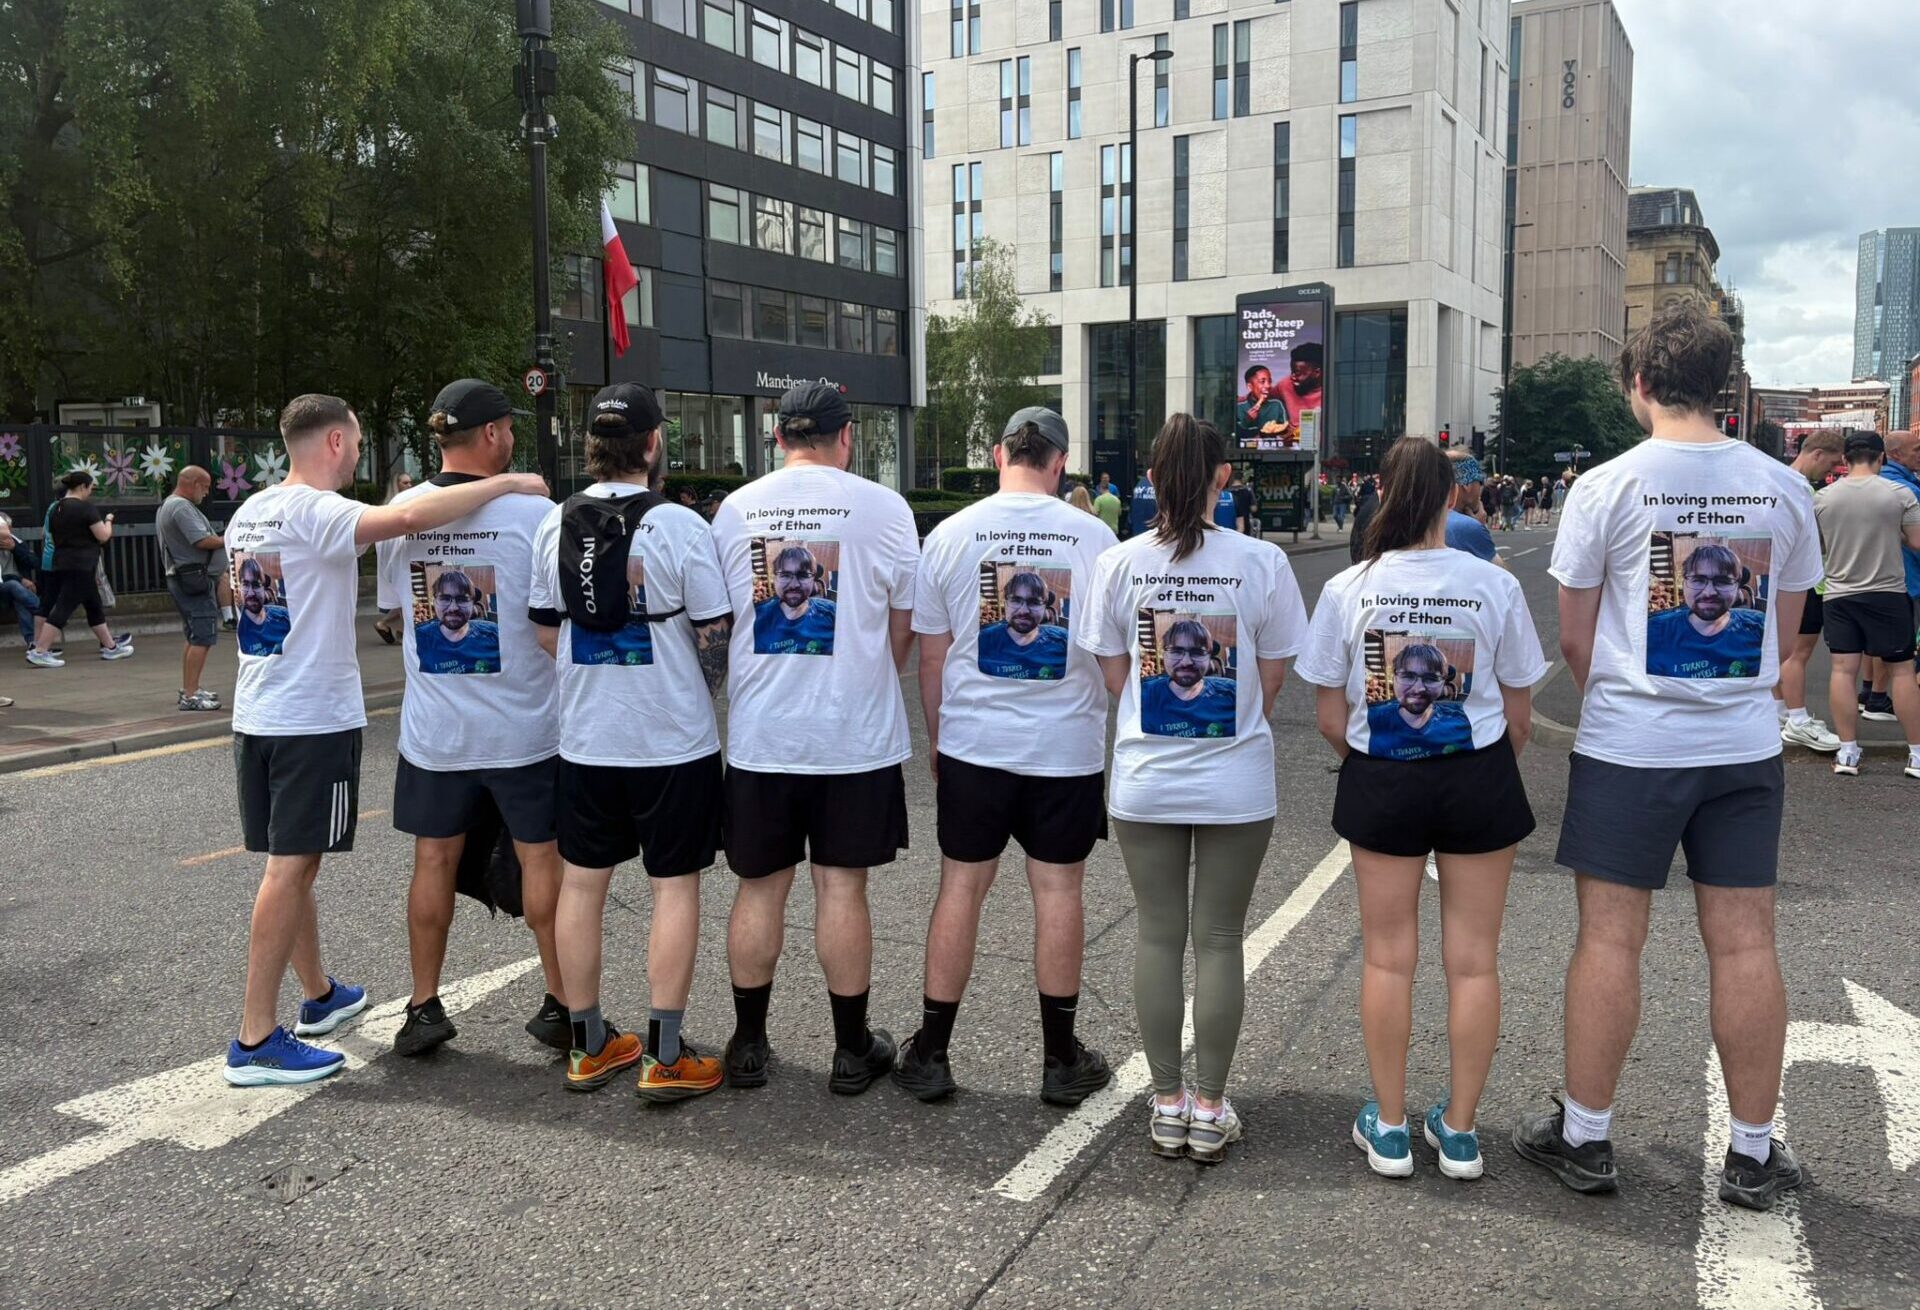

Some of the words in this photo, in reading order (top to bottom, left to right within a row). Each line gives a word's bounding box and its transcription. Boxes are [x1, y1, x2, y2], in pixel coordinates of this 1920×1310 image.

[1242, 309, 1276, 320] Dads,
[1248, 319, 1273, 329] let's
[1275, 318, 1304, 330] keep
[1242, 329, 1262, 340] the
[1263, 328, 1296, 340] jokes
[1245, 339, 1288, 350] coming
[527, 375, 544, 387] 20
[1643, 494, 1658, 506] In
[1661, 493, 1707, 509] loving
[1711, 495, 1778, 509] memory
[746, 511, 756, 520] In
[758, 507, 795, 518] loving
[798, 508, 851, 518] memory
[1677, 512, 1694, 524] of
[1697, 512, 1745, 524] Ethan
[769, 521, 783, 531] of
[785, 520, 822, 531] Ethan
[416, 531, 450, 543] loving
[453, 531, 499, 541] memory
[976, 532, 987, 542] In
[989, 530, 1026, 542] loving
[1028, 532, 1079, 546] memory
[427, 546, 441, 556] of
[442, 546, 475, 556] Ethan
[1001, 545, 1015, 556] of
[1017, 545, 1053, 556] Ethan
[580, 537, 597, 614] INOXTO
[1132, 575, 1143, 586] In
[1145, 574, 1185, 587] loving
[1187, 576, 1242, 589] memory
[1157, 590, 1173, 601] of
[1175, 590, 1215, 602] Ethan
[1361, 598, 1372, 609] In
[1376, 594, 1419, 608] loving
[1422, 597, 1482, 612] memory
[1389, 612, 1406, 623] of
[1408, 612, 1452, 625] Ethan
[655, 1067, 682, 1080] HOKA
